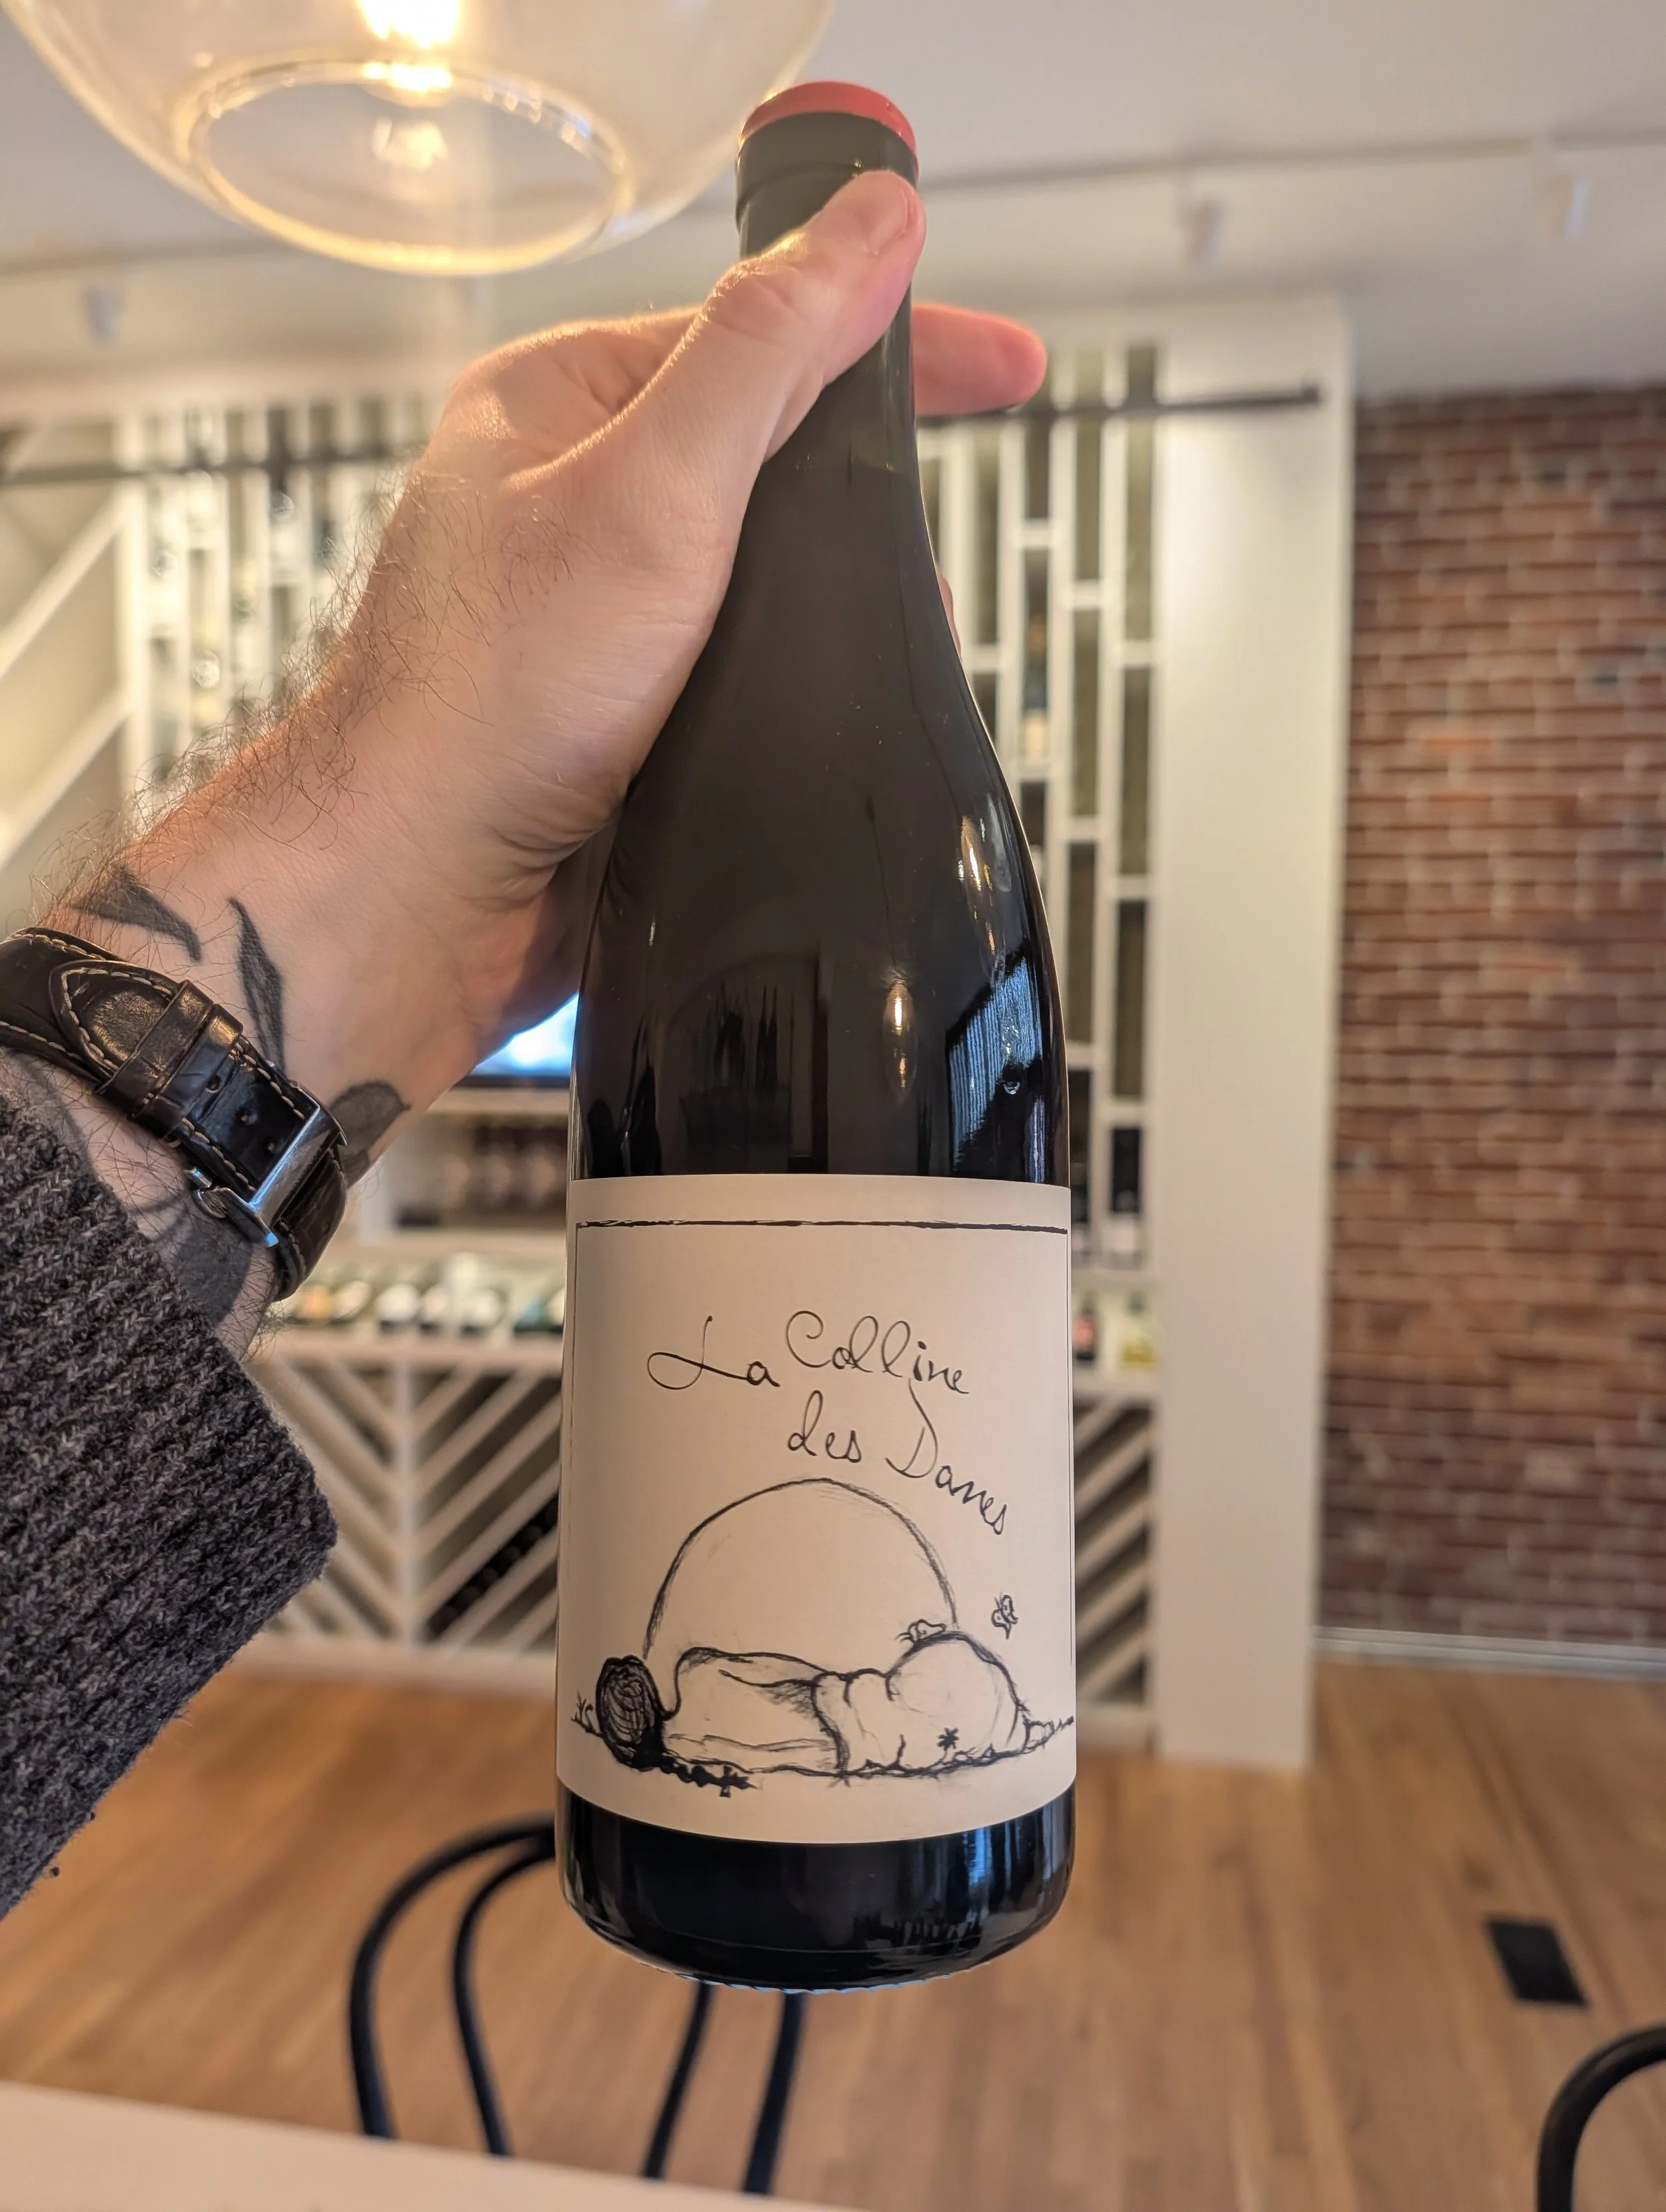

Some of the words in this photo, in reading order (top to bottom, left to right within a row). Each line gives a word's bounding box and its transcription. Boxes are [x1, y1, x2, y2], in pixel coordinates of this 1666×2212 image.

[647, 1316, 780, 1390] La
[786, 1311, 970, 1394] Colline
[787, 1390, 862, 1463] des
